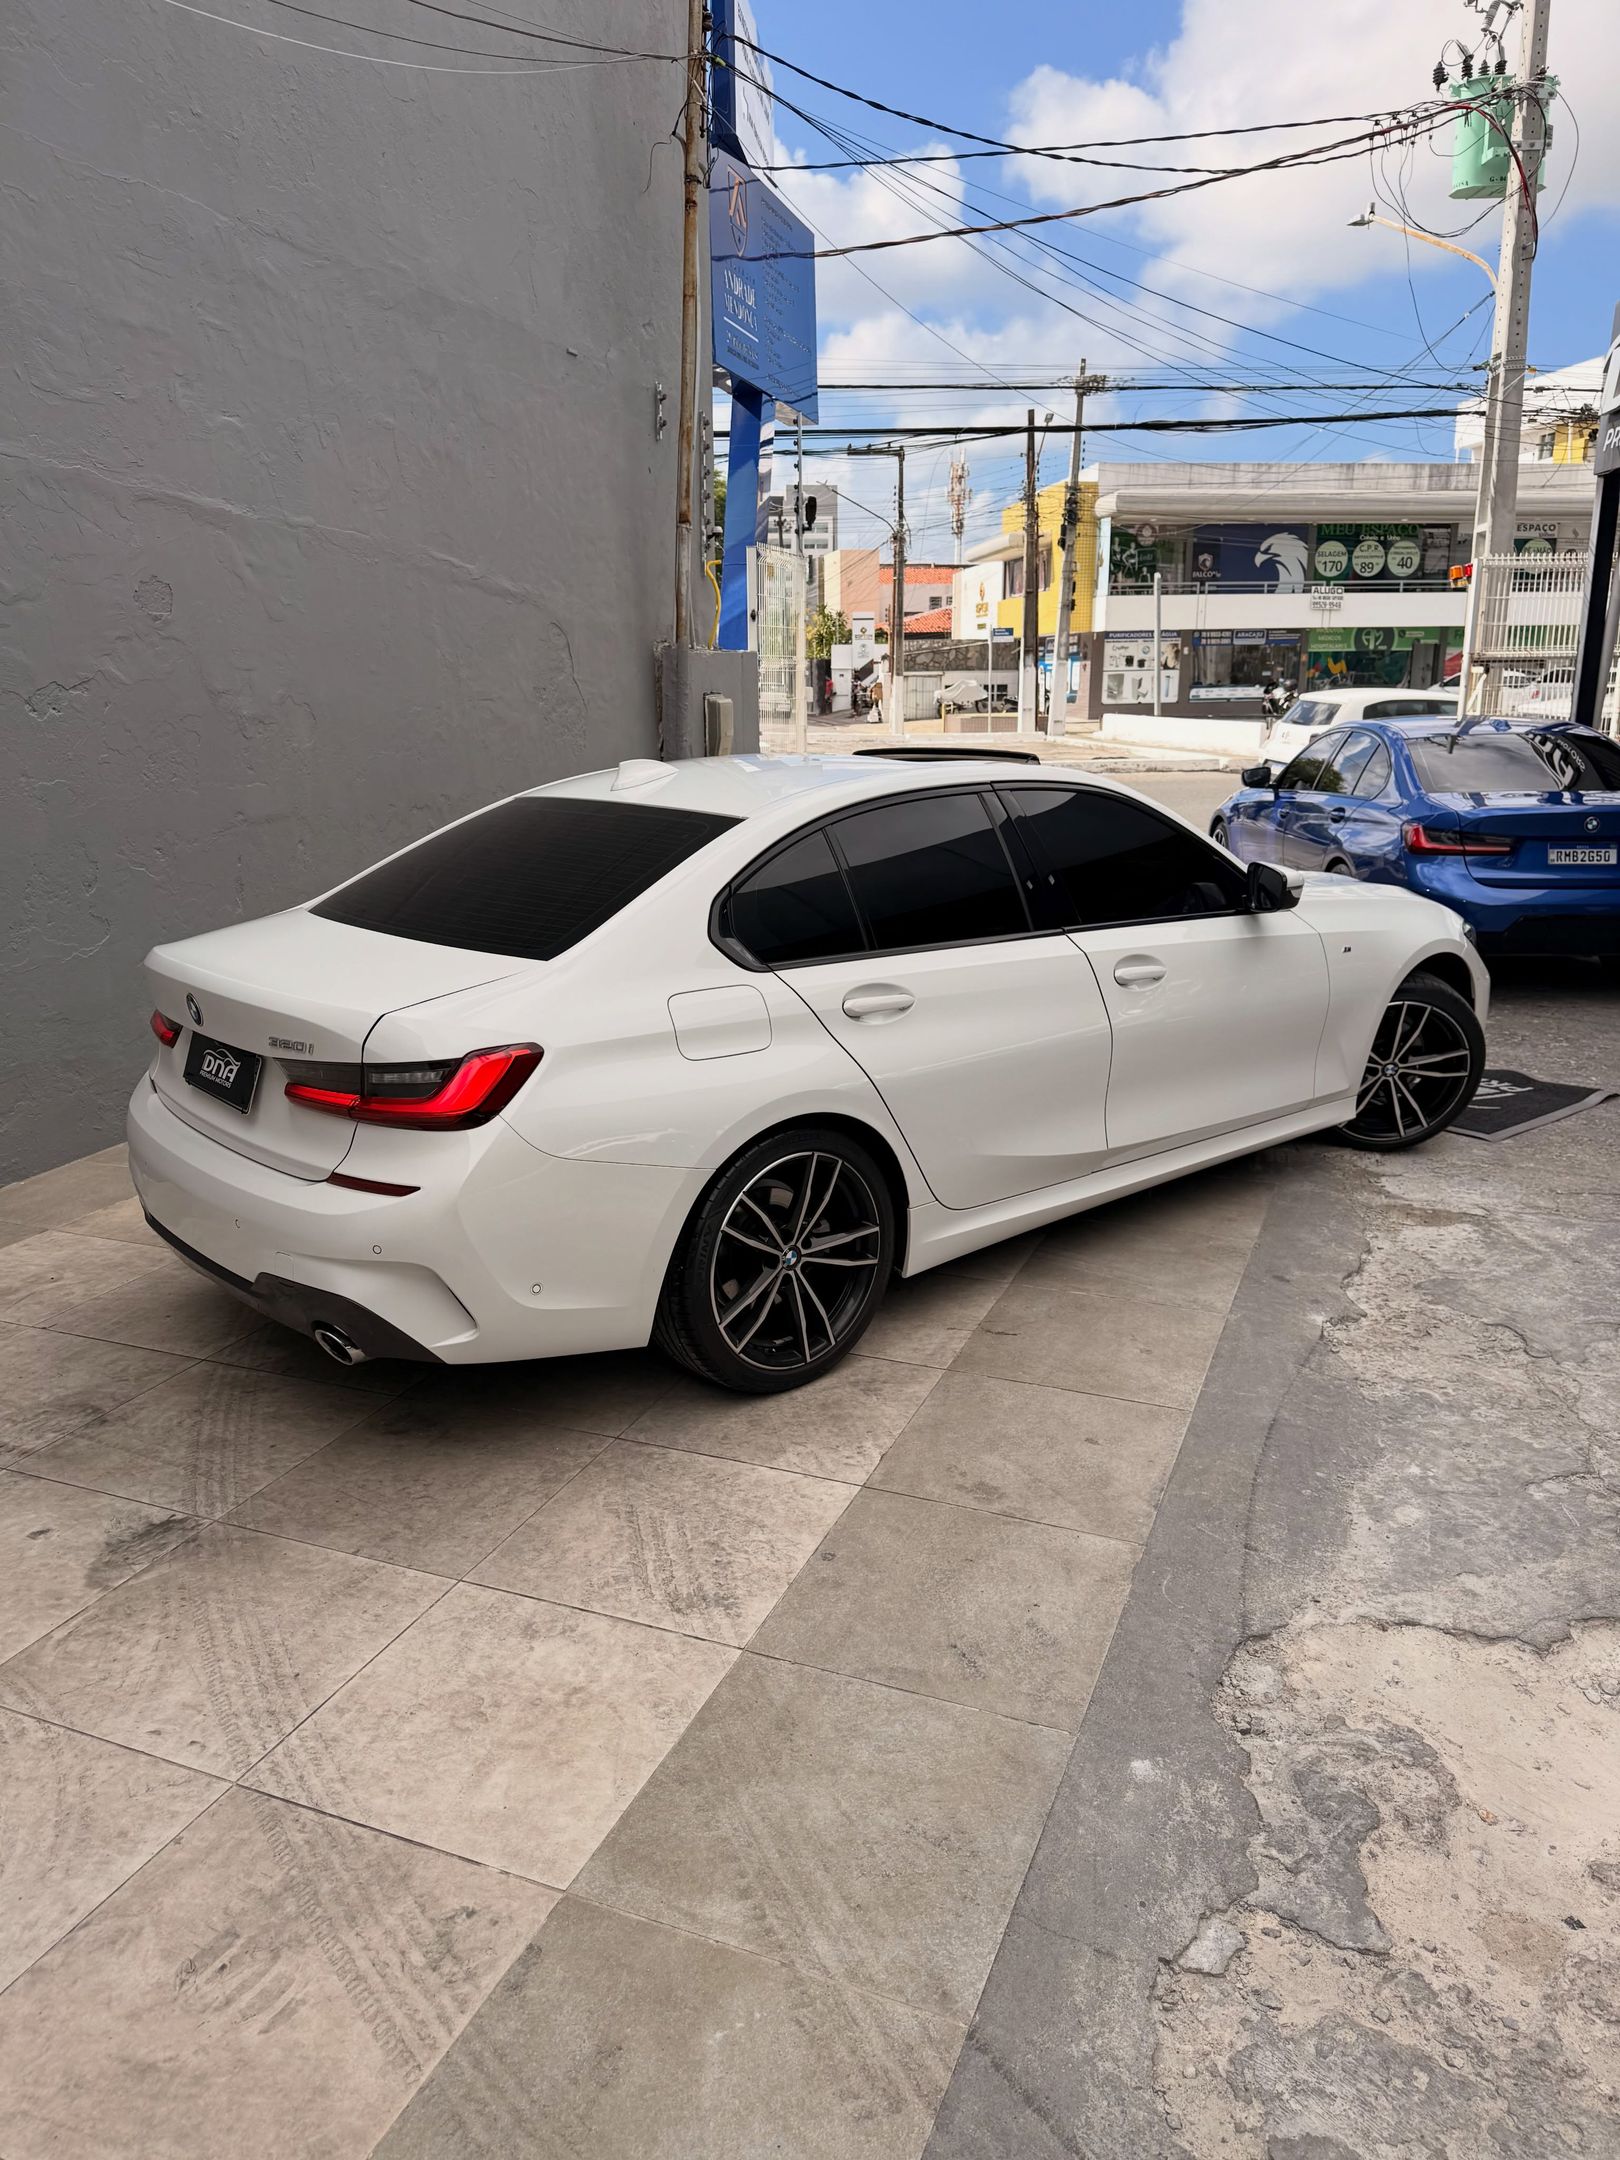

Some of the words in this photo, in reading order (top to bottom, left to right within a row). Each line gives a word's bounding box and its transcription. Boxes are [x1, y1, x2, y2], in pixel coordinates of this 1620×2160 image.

[1321, 524, 1355, 535] MEU
[1322, 561, 1343, 572] 170
[1360, 562, 1374, 573] 89
[1397, 556, 1413, 569] 40
[1312, 587, 1344, 595] ALUGO
[1556, 850, 1611, 863] RMB2G50
[202, 1054, 239, 1082] DNA
[200, 1069, 217, 1081] PREMIUM
[214, 1076, 232, 1089] MOTORS
